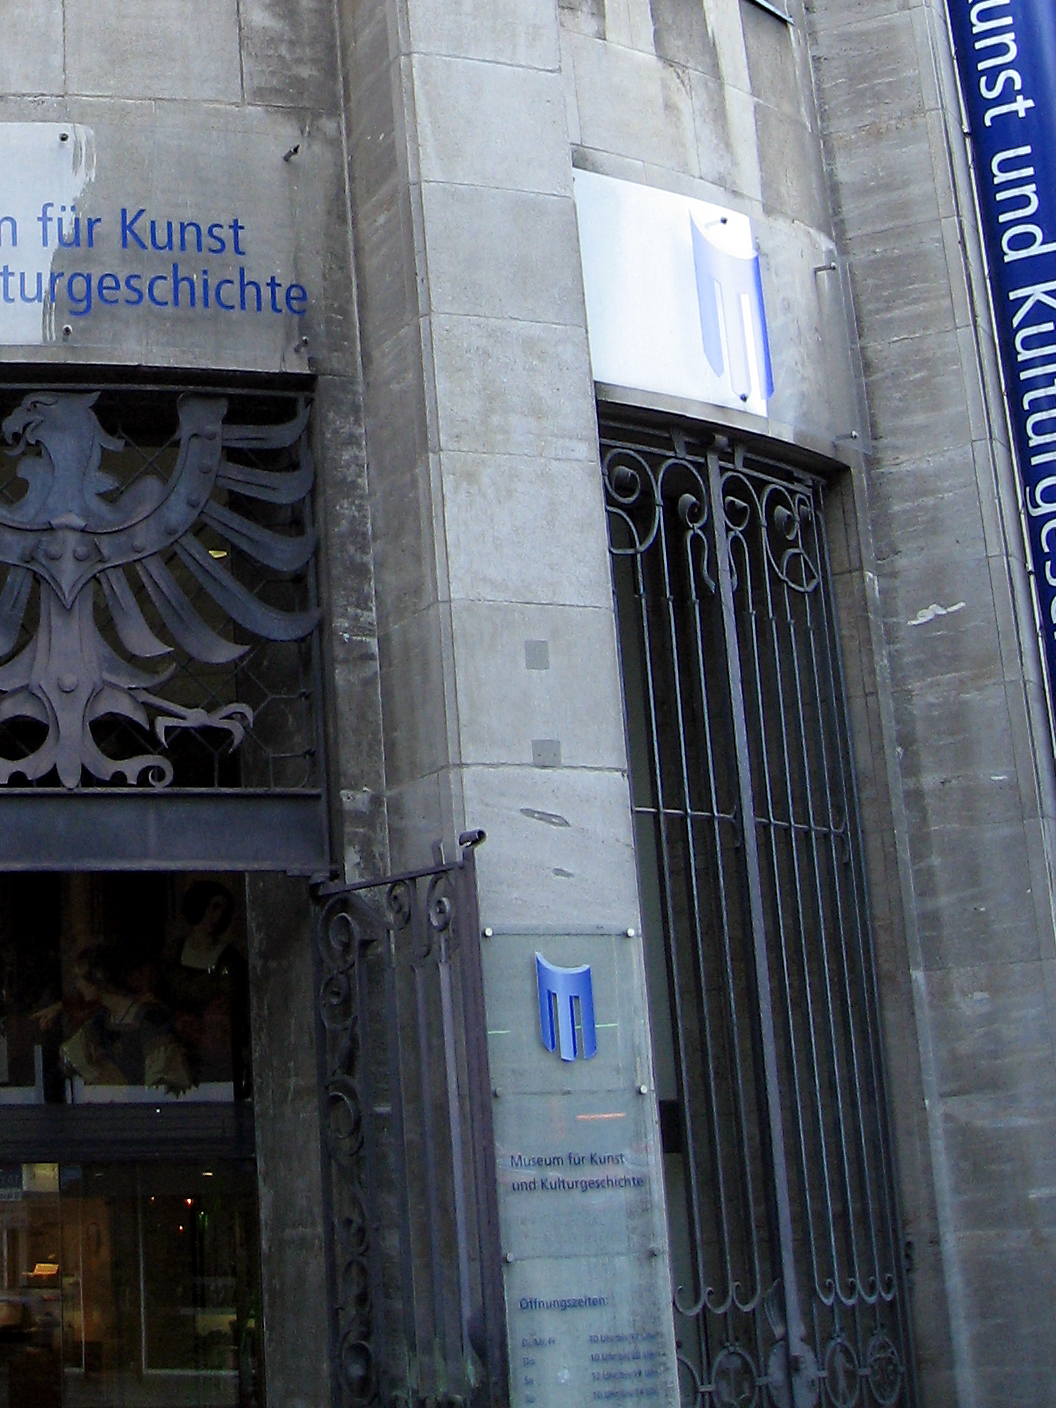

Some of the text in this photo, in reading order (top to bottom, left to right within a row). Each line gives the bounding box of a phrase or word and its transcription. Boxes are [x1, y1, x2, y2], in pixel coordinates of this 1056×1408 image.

[991, 145, 1056, 263] und
[38, 202, 102, 248] für
[121, 207, 246, 256] Kunst
[510, 1154, 564, 1167] Museum
[590, 1152, 625, 1166] Kunst
[511, 1175, 644, 1192] und Kulturgeschichte
